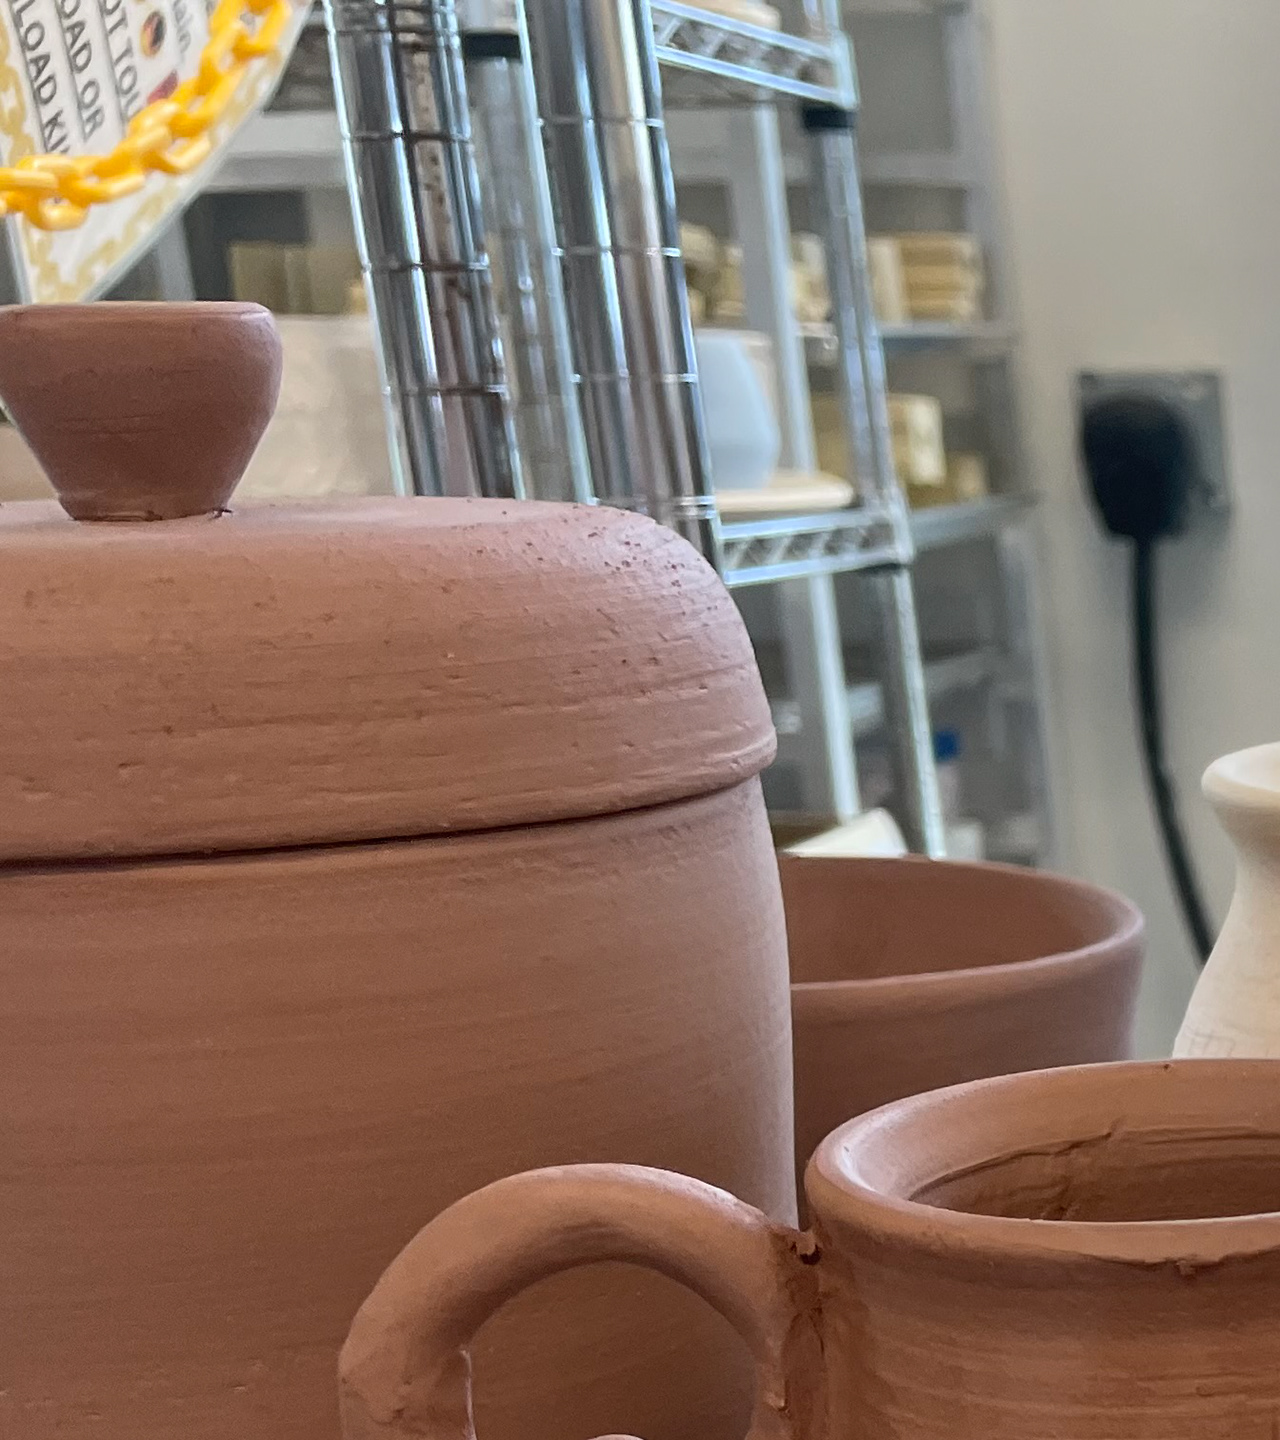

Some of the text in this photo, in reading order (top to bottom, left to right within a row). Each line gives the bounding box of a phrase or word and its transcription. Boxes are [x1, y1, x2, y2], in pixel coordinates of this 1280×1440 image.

[12, 0, 70, 153] LOAD KI
[80, 78, 104, 142] OR
